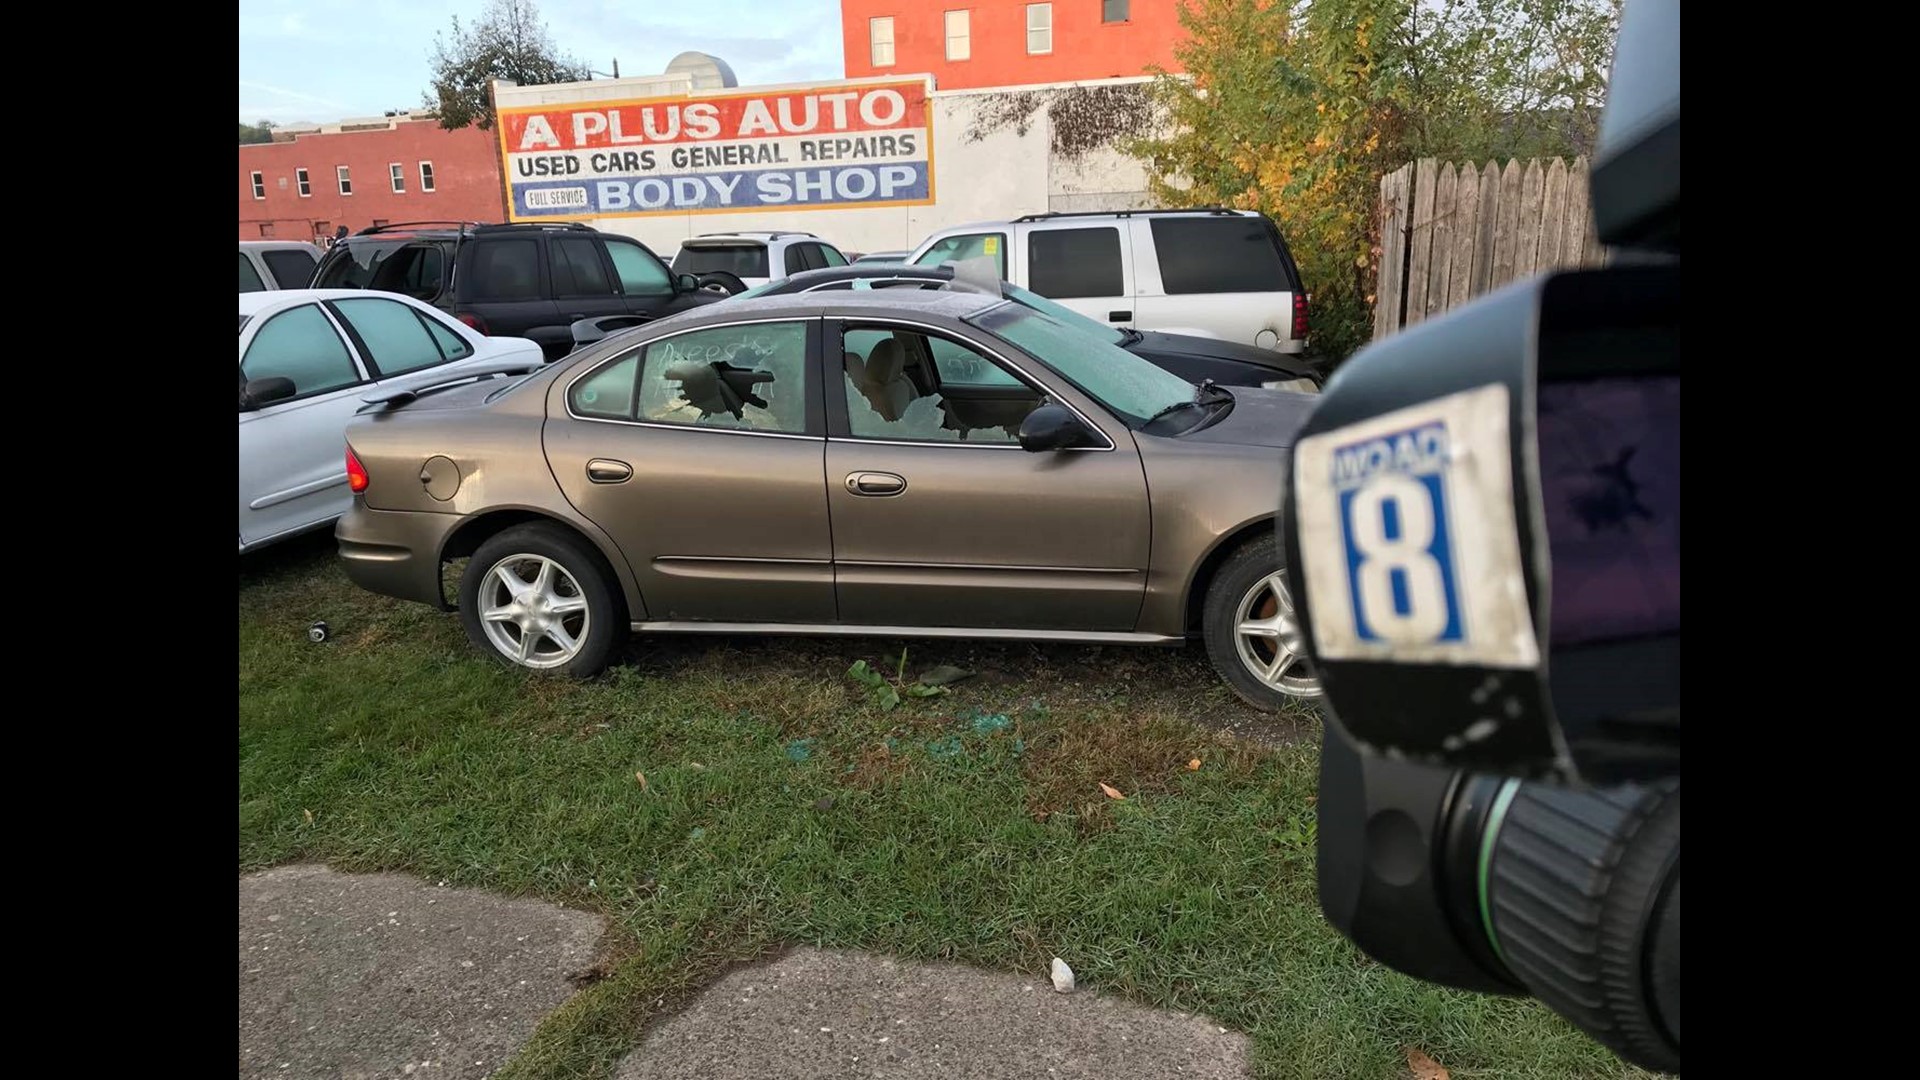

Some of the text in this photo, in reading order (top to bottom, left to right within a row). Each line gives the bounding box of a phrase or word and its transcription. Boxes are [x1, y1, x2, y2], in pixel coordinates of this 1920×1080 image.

[519, 89, 906, 149] A PLUS AUTO
[517, 134, 916, 177] USED CARS GENERAL REPAIRS
[529, 188, 585, 206] FULL SERVICE
[596, 165, 917, 210] BODY SHOP
[1349, 478, 1450, 644] 8
